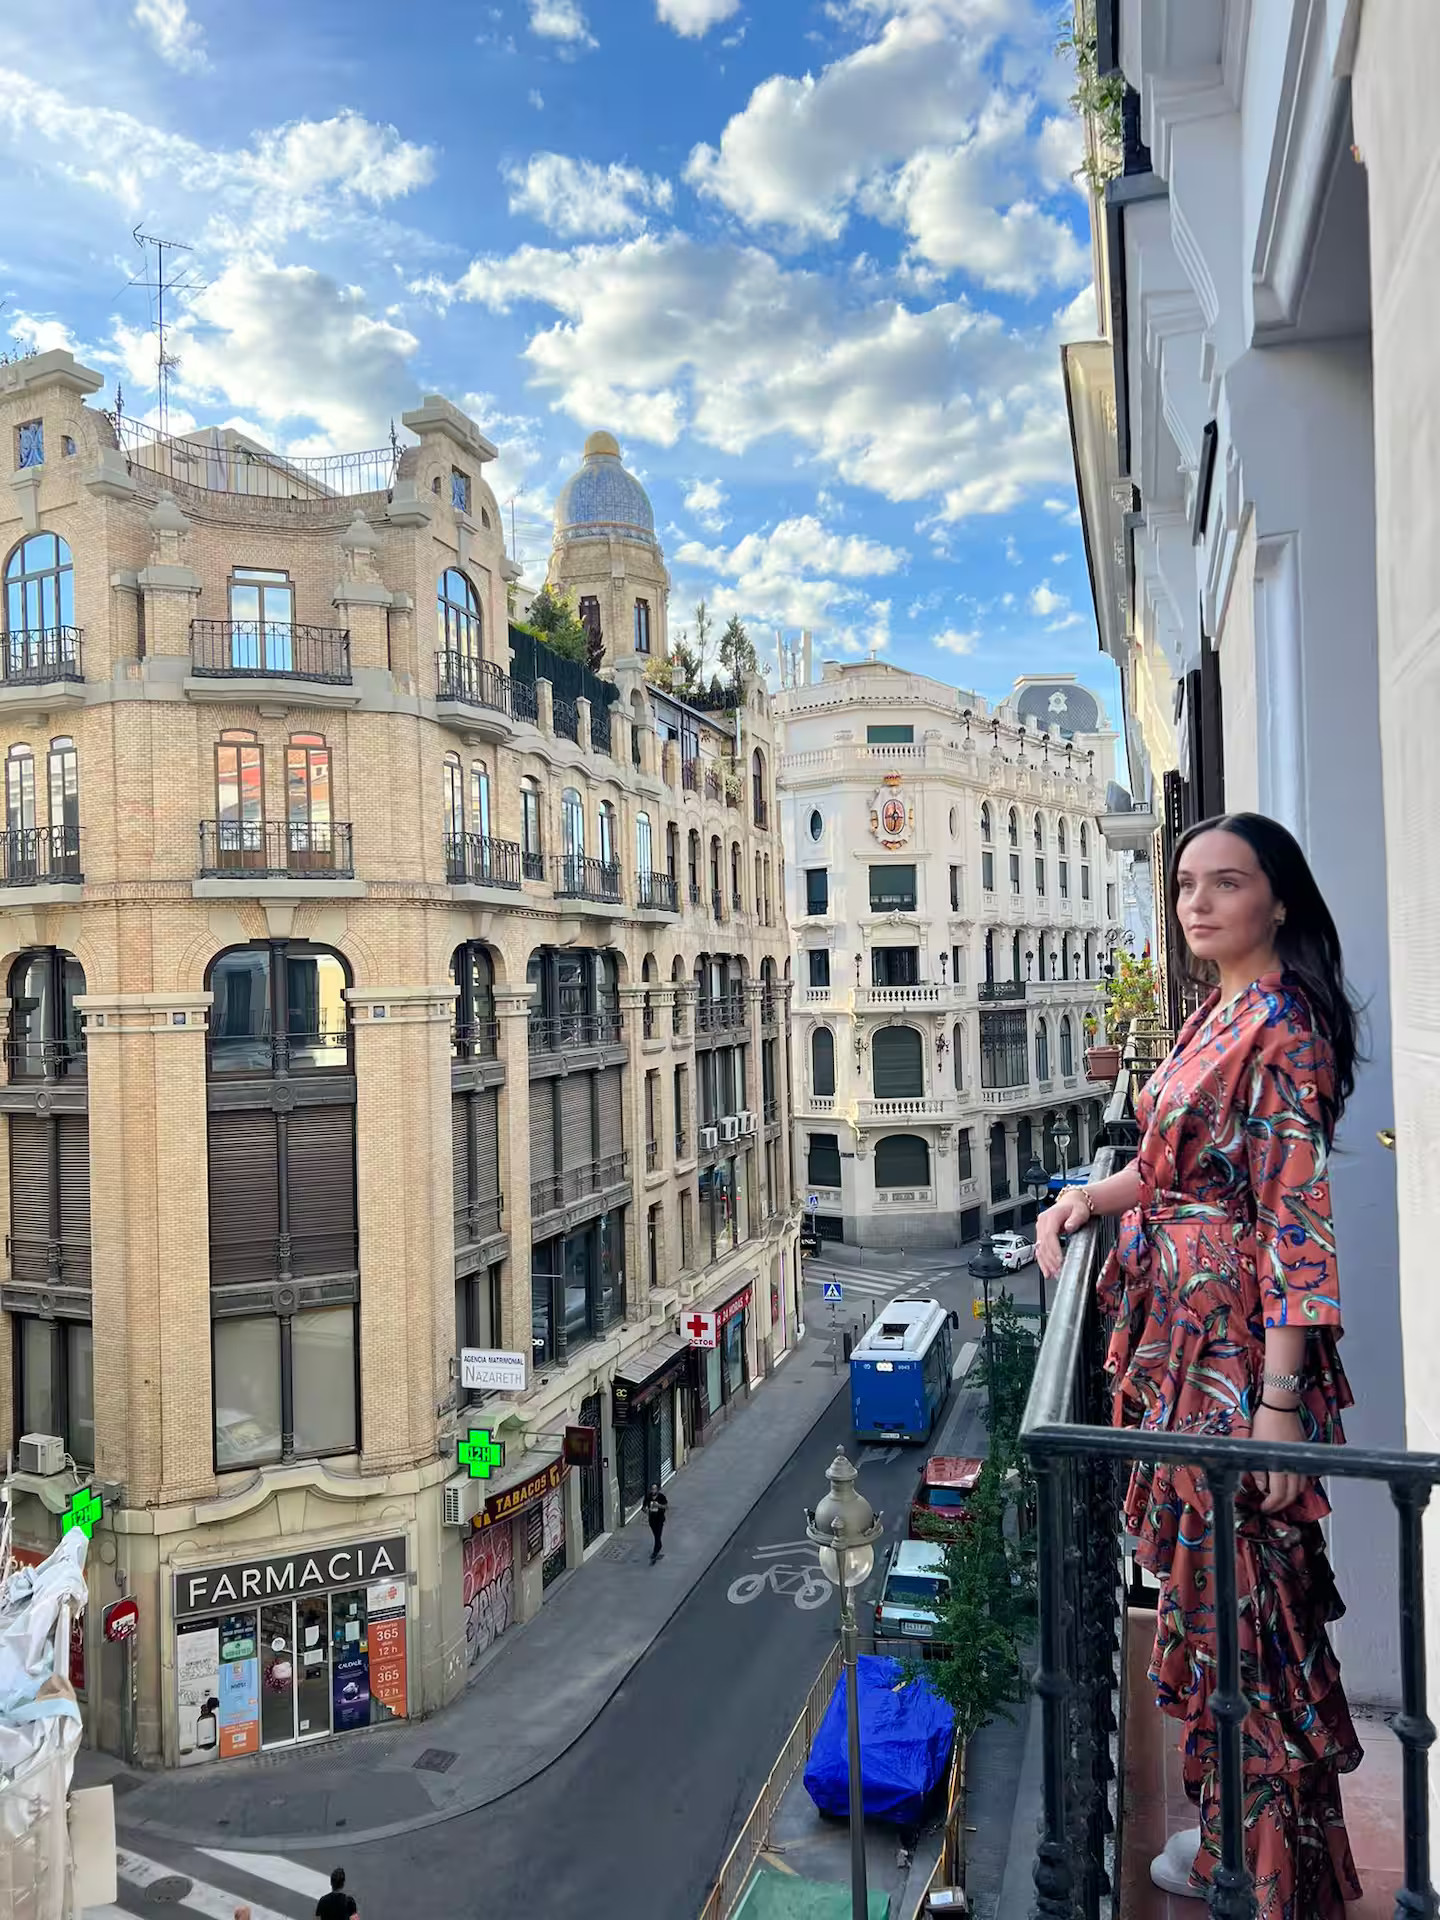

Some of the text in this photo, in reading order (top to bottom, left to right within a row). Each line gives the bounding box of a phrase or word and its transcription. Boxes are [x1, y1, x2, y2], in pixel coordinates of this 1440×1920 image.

[464, 1355, 524, 1366] AGENCIA MATRIMONIAL
[468, 1446, 490, 1462] 12H
[496, 1474, 547, 1512] TABACOS
[188, 1546, 395, 1608] FARMACIA
[376, 1628, 399, 1641] 365
[379, 1647, 389, 1656] 12
[377, 1669, 400, 1683] 365
[380, 1689, 390, 1698] 12
